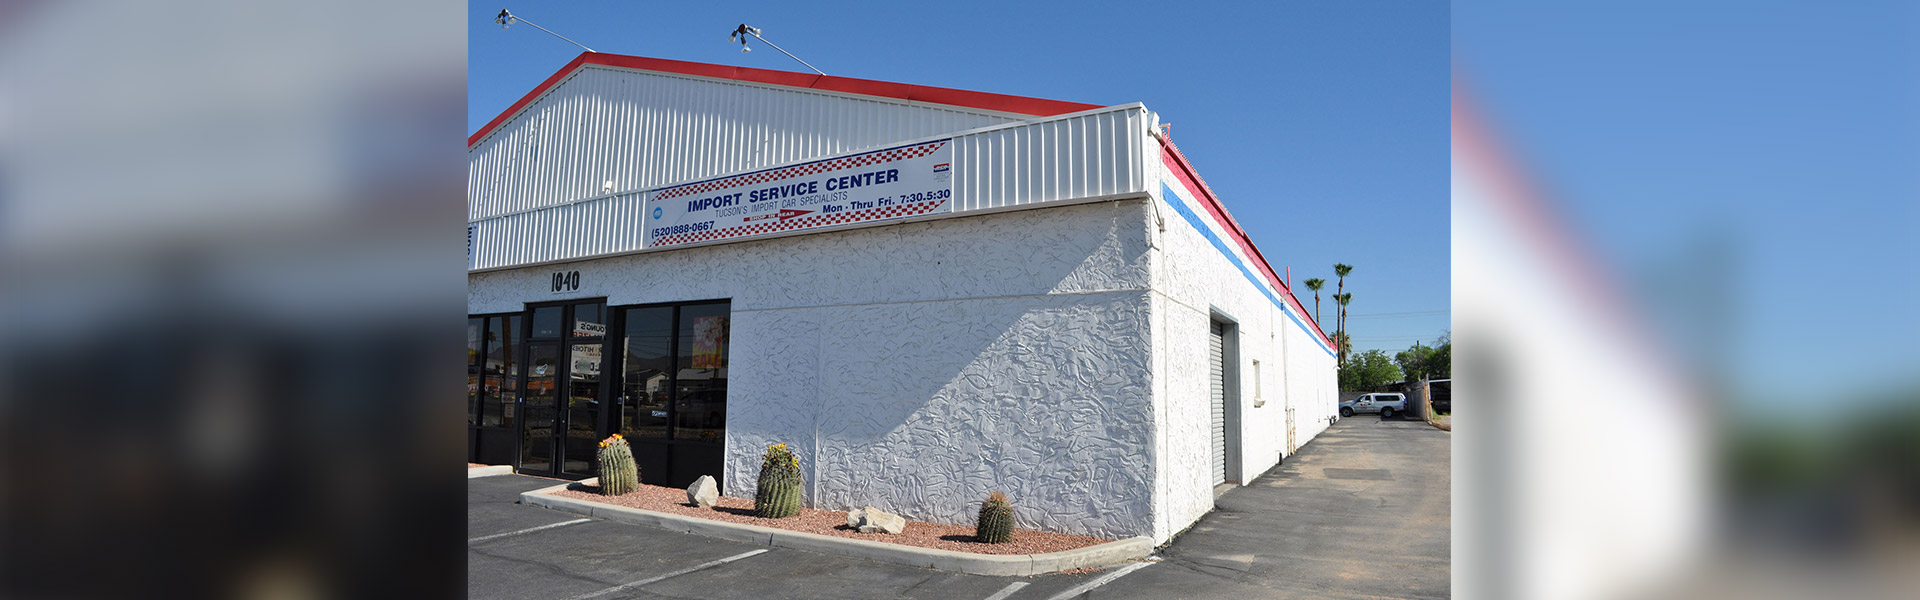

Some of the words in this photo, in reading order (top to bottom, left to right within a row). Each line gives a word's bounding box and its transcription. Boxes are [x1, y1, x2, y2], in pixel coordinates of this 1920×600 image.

[688, 193, 742, 212] IMPORT
[749, 181, 818, 203] SERVICE
[826, 169, 899, 191] CENTER
[716, 206, 748, 218] TUCSON'S
[751, 201, 778, 213] IMPORT
[782, 198, 796, 208] CAR
[800, 191, 848, 207] SPECIALISTS
[822, 204, 843, 213] Mon
[850, 201, 873, 210] Thru
[551, 271, 580, 292] 1040
[693, 353, 721, 368] SALE
